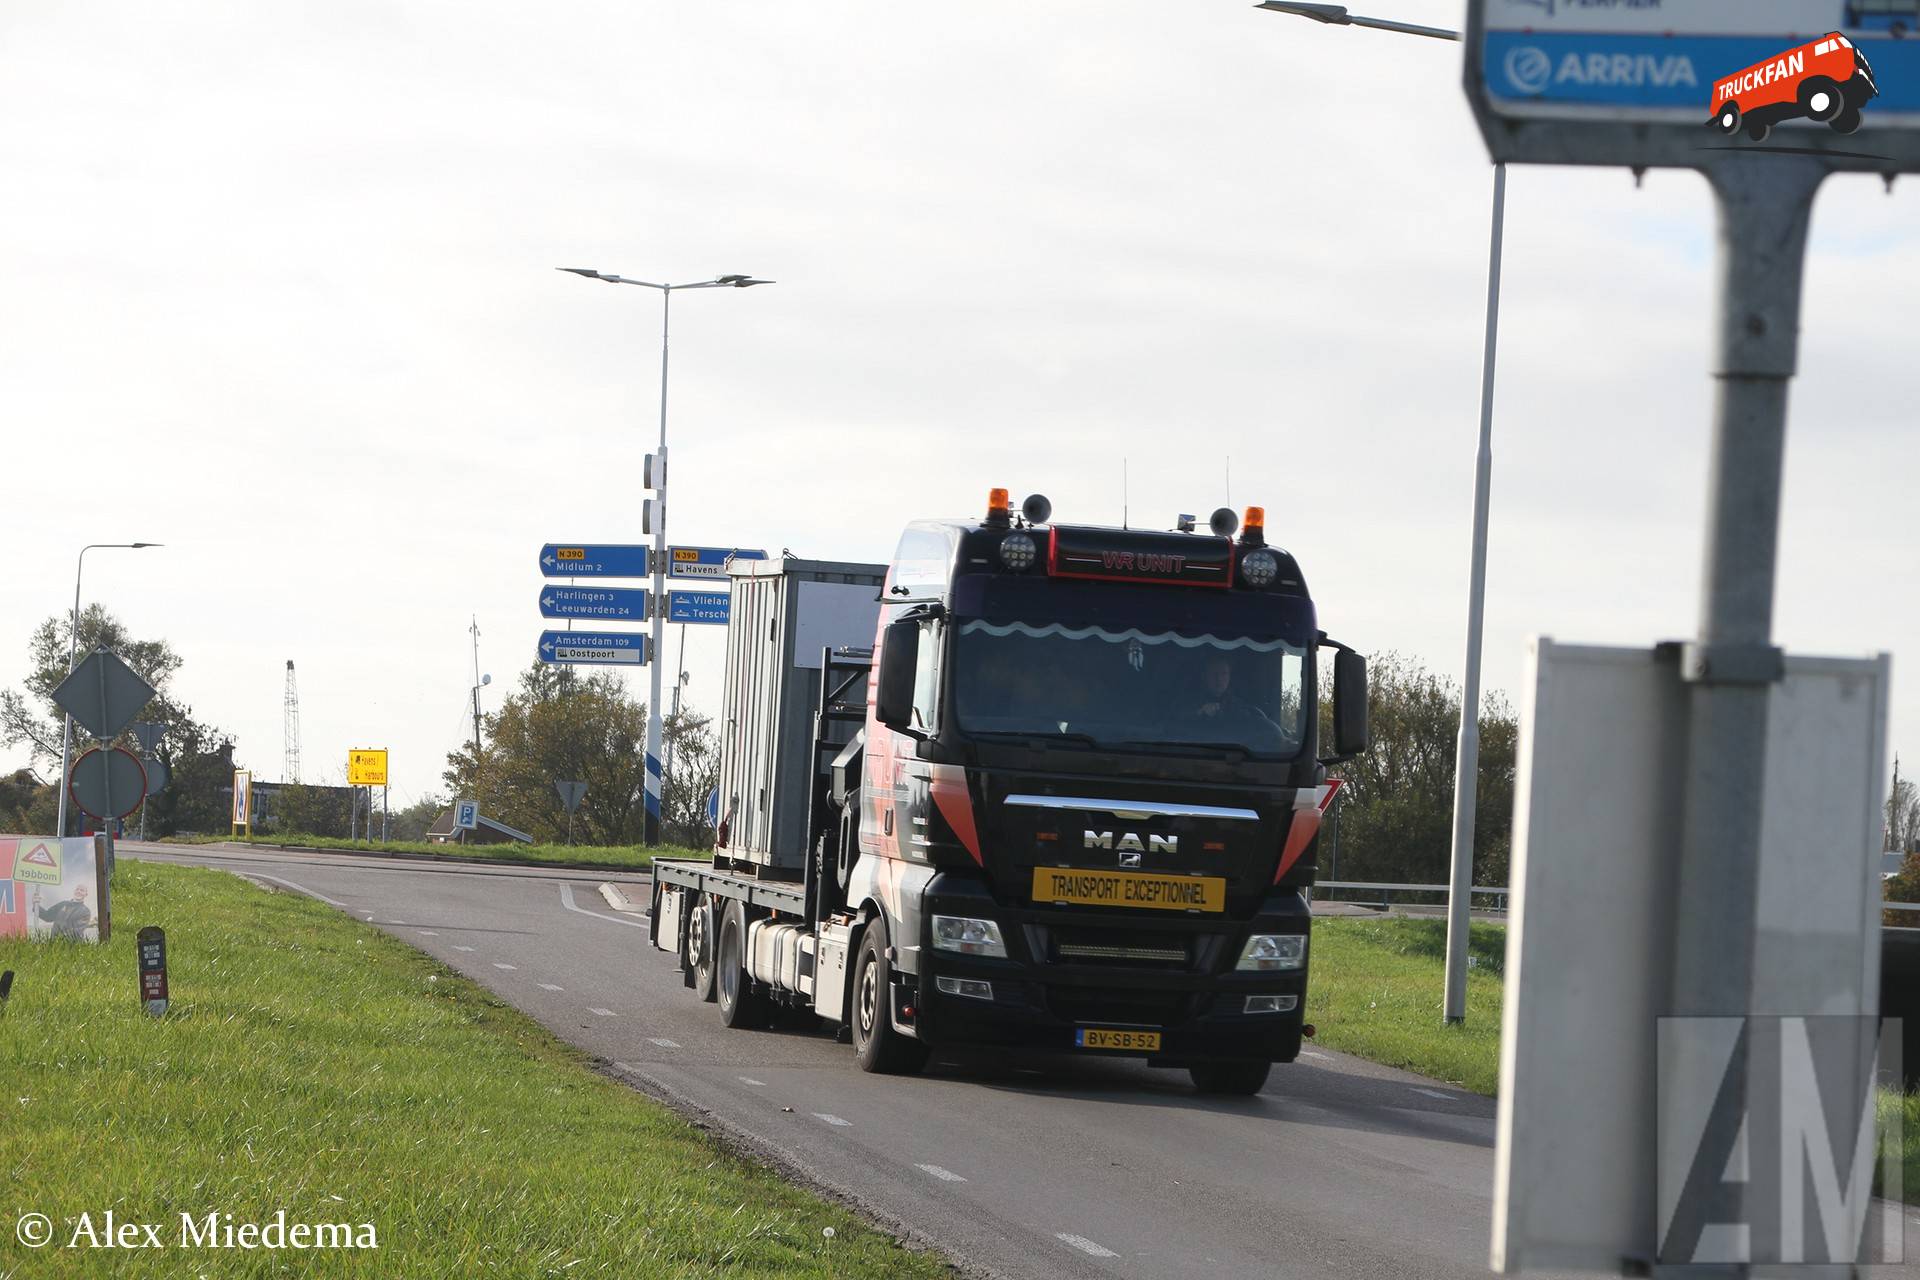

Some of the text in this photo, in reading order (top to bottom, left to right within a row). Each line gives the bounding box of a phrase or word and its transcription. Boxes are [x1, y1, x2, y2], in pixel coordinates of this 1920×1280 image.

[1556, 52, 1699, 87] ARRIVA
[558, 550, 583, 558] N 390
[675, 551, 697, 560] N 390
[556, 563, 593, 571] Midlum
[1137, 553, 1186, 573] UNIT
[686, 565, 718, 574] Havens
[556, 591, 605, 602] Harlingen
[693, 595, 728, 605] Vlielan
[556, 604, 629, 615] Leeuwarden 24
[555, 636, 612, 645] Amsterdam
[570, 649, 615, 658] Oostpoort
[1083, 830, 1178, 853] MAN
[1051, 875, 1207, 905] TRANSPORT EXCEPTIONNEL
[1088, 1031, 1156, 1048] BV-SB-52
